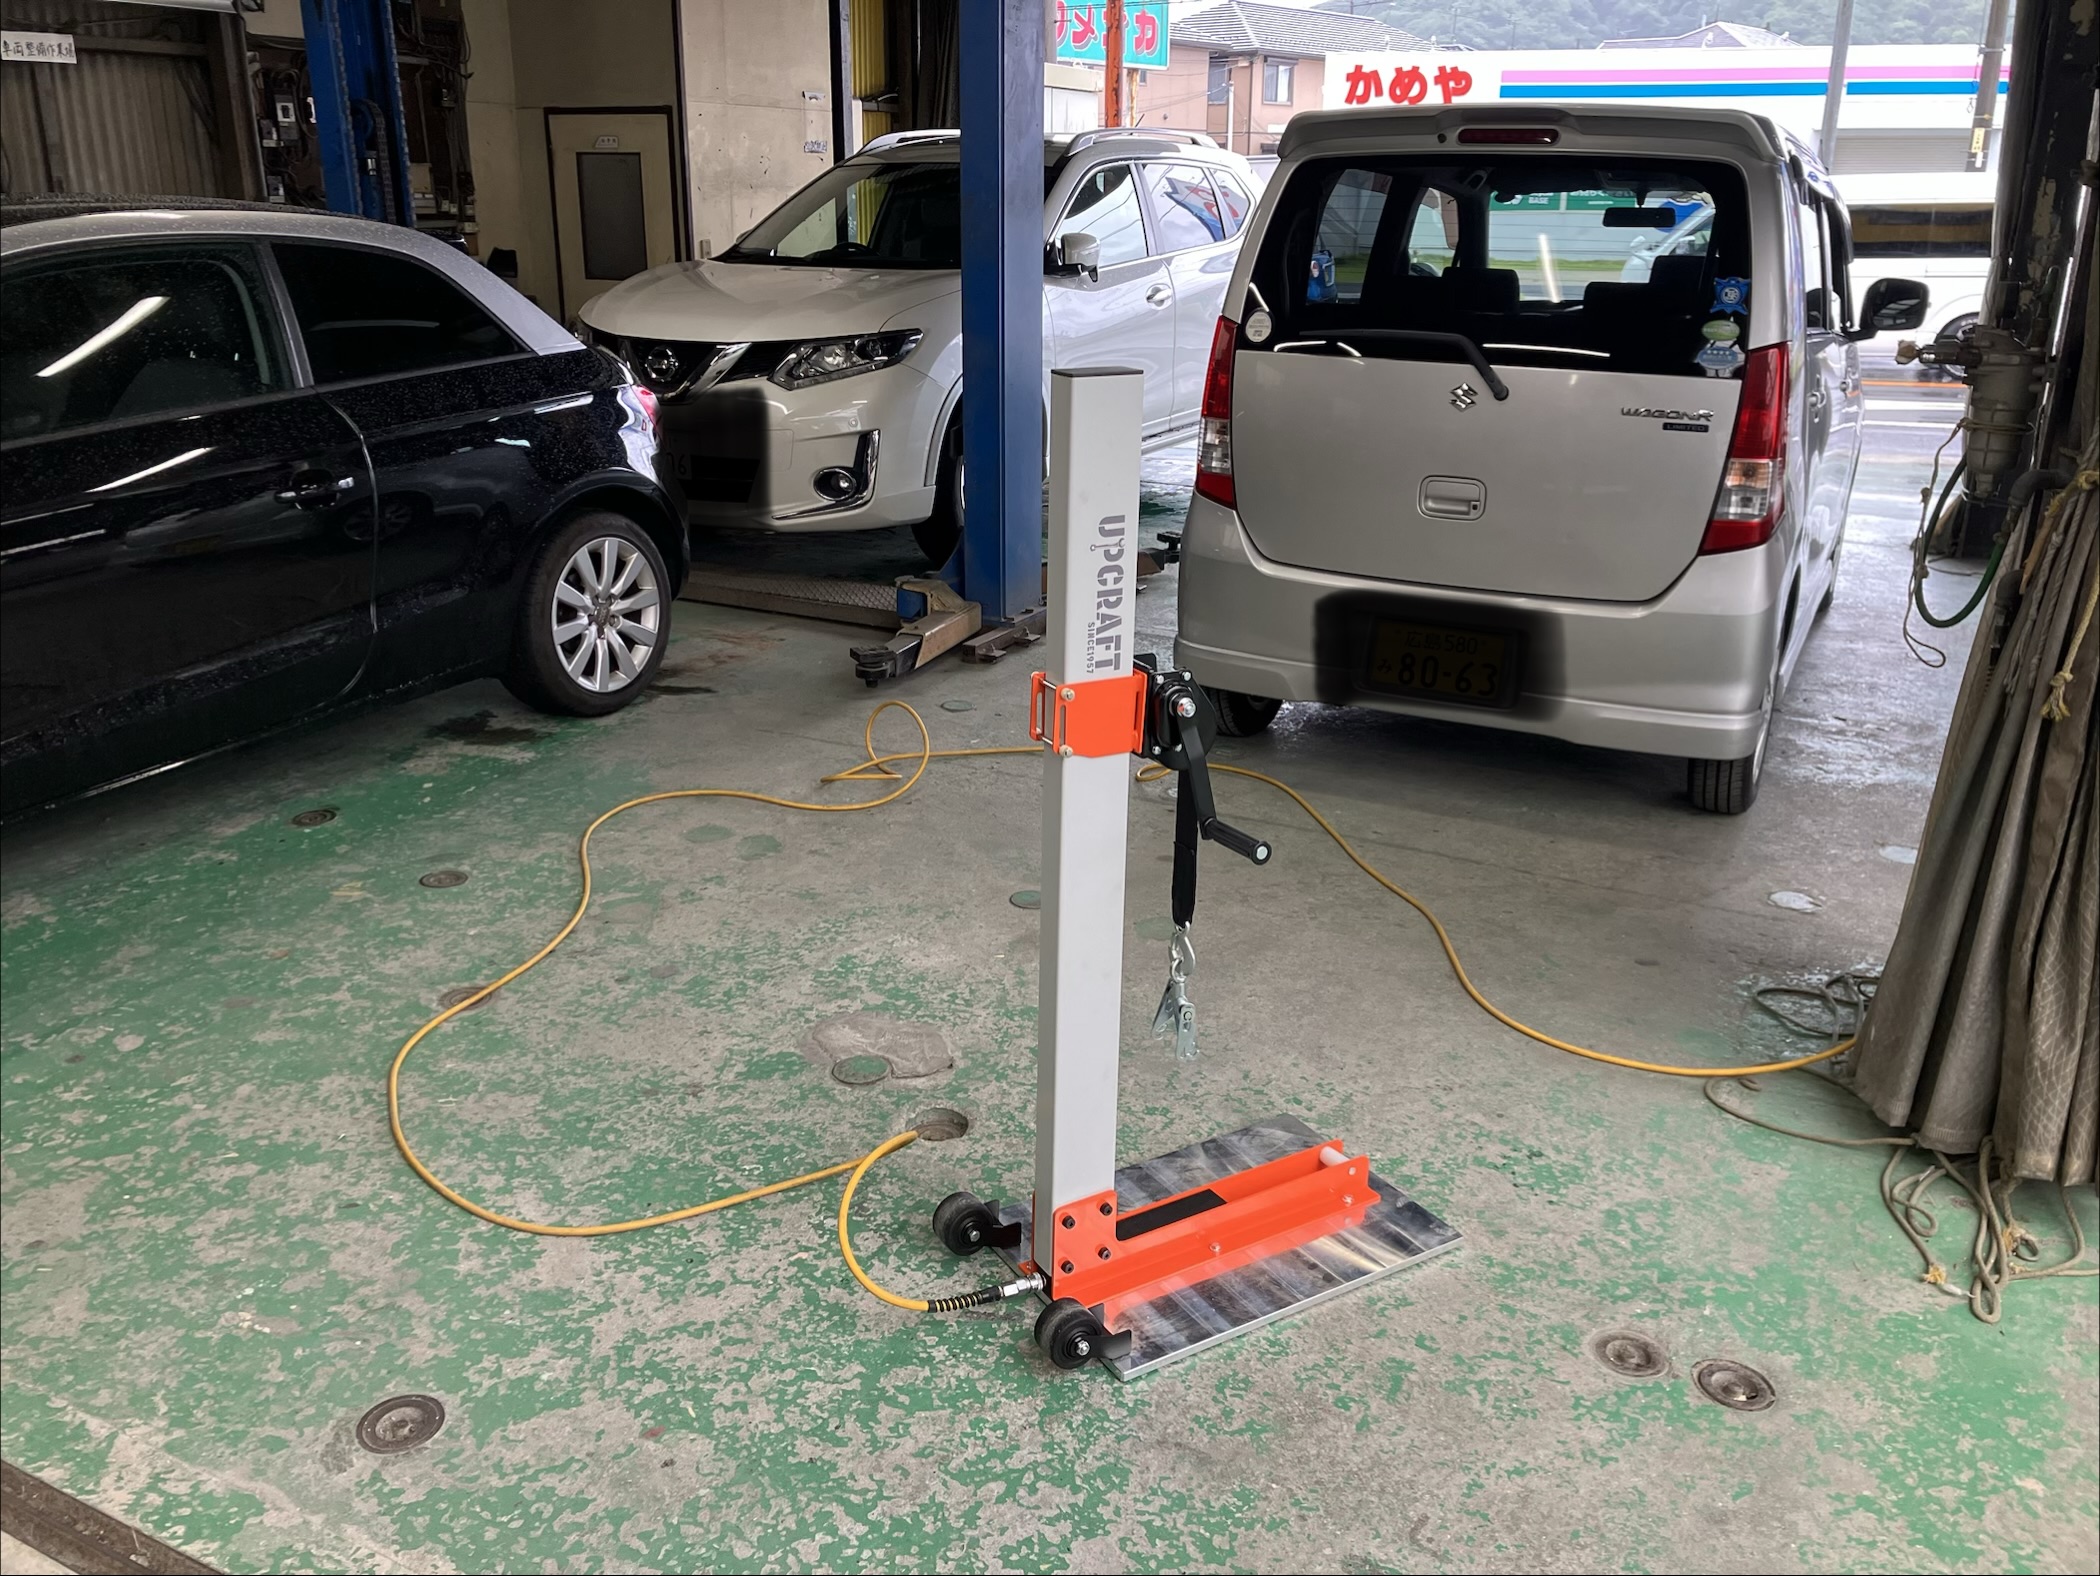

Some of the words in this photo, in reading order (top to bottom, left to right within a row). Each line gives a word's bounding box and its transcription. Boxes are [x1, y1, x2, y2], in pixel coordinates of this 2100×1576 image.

[1344, 64, 1473, 105] かめや
[1090, 514, 1126, 671] UPCRAFT
[1398, 652, 1498, 696] 80-63
